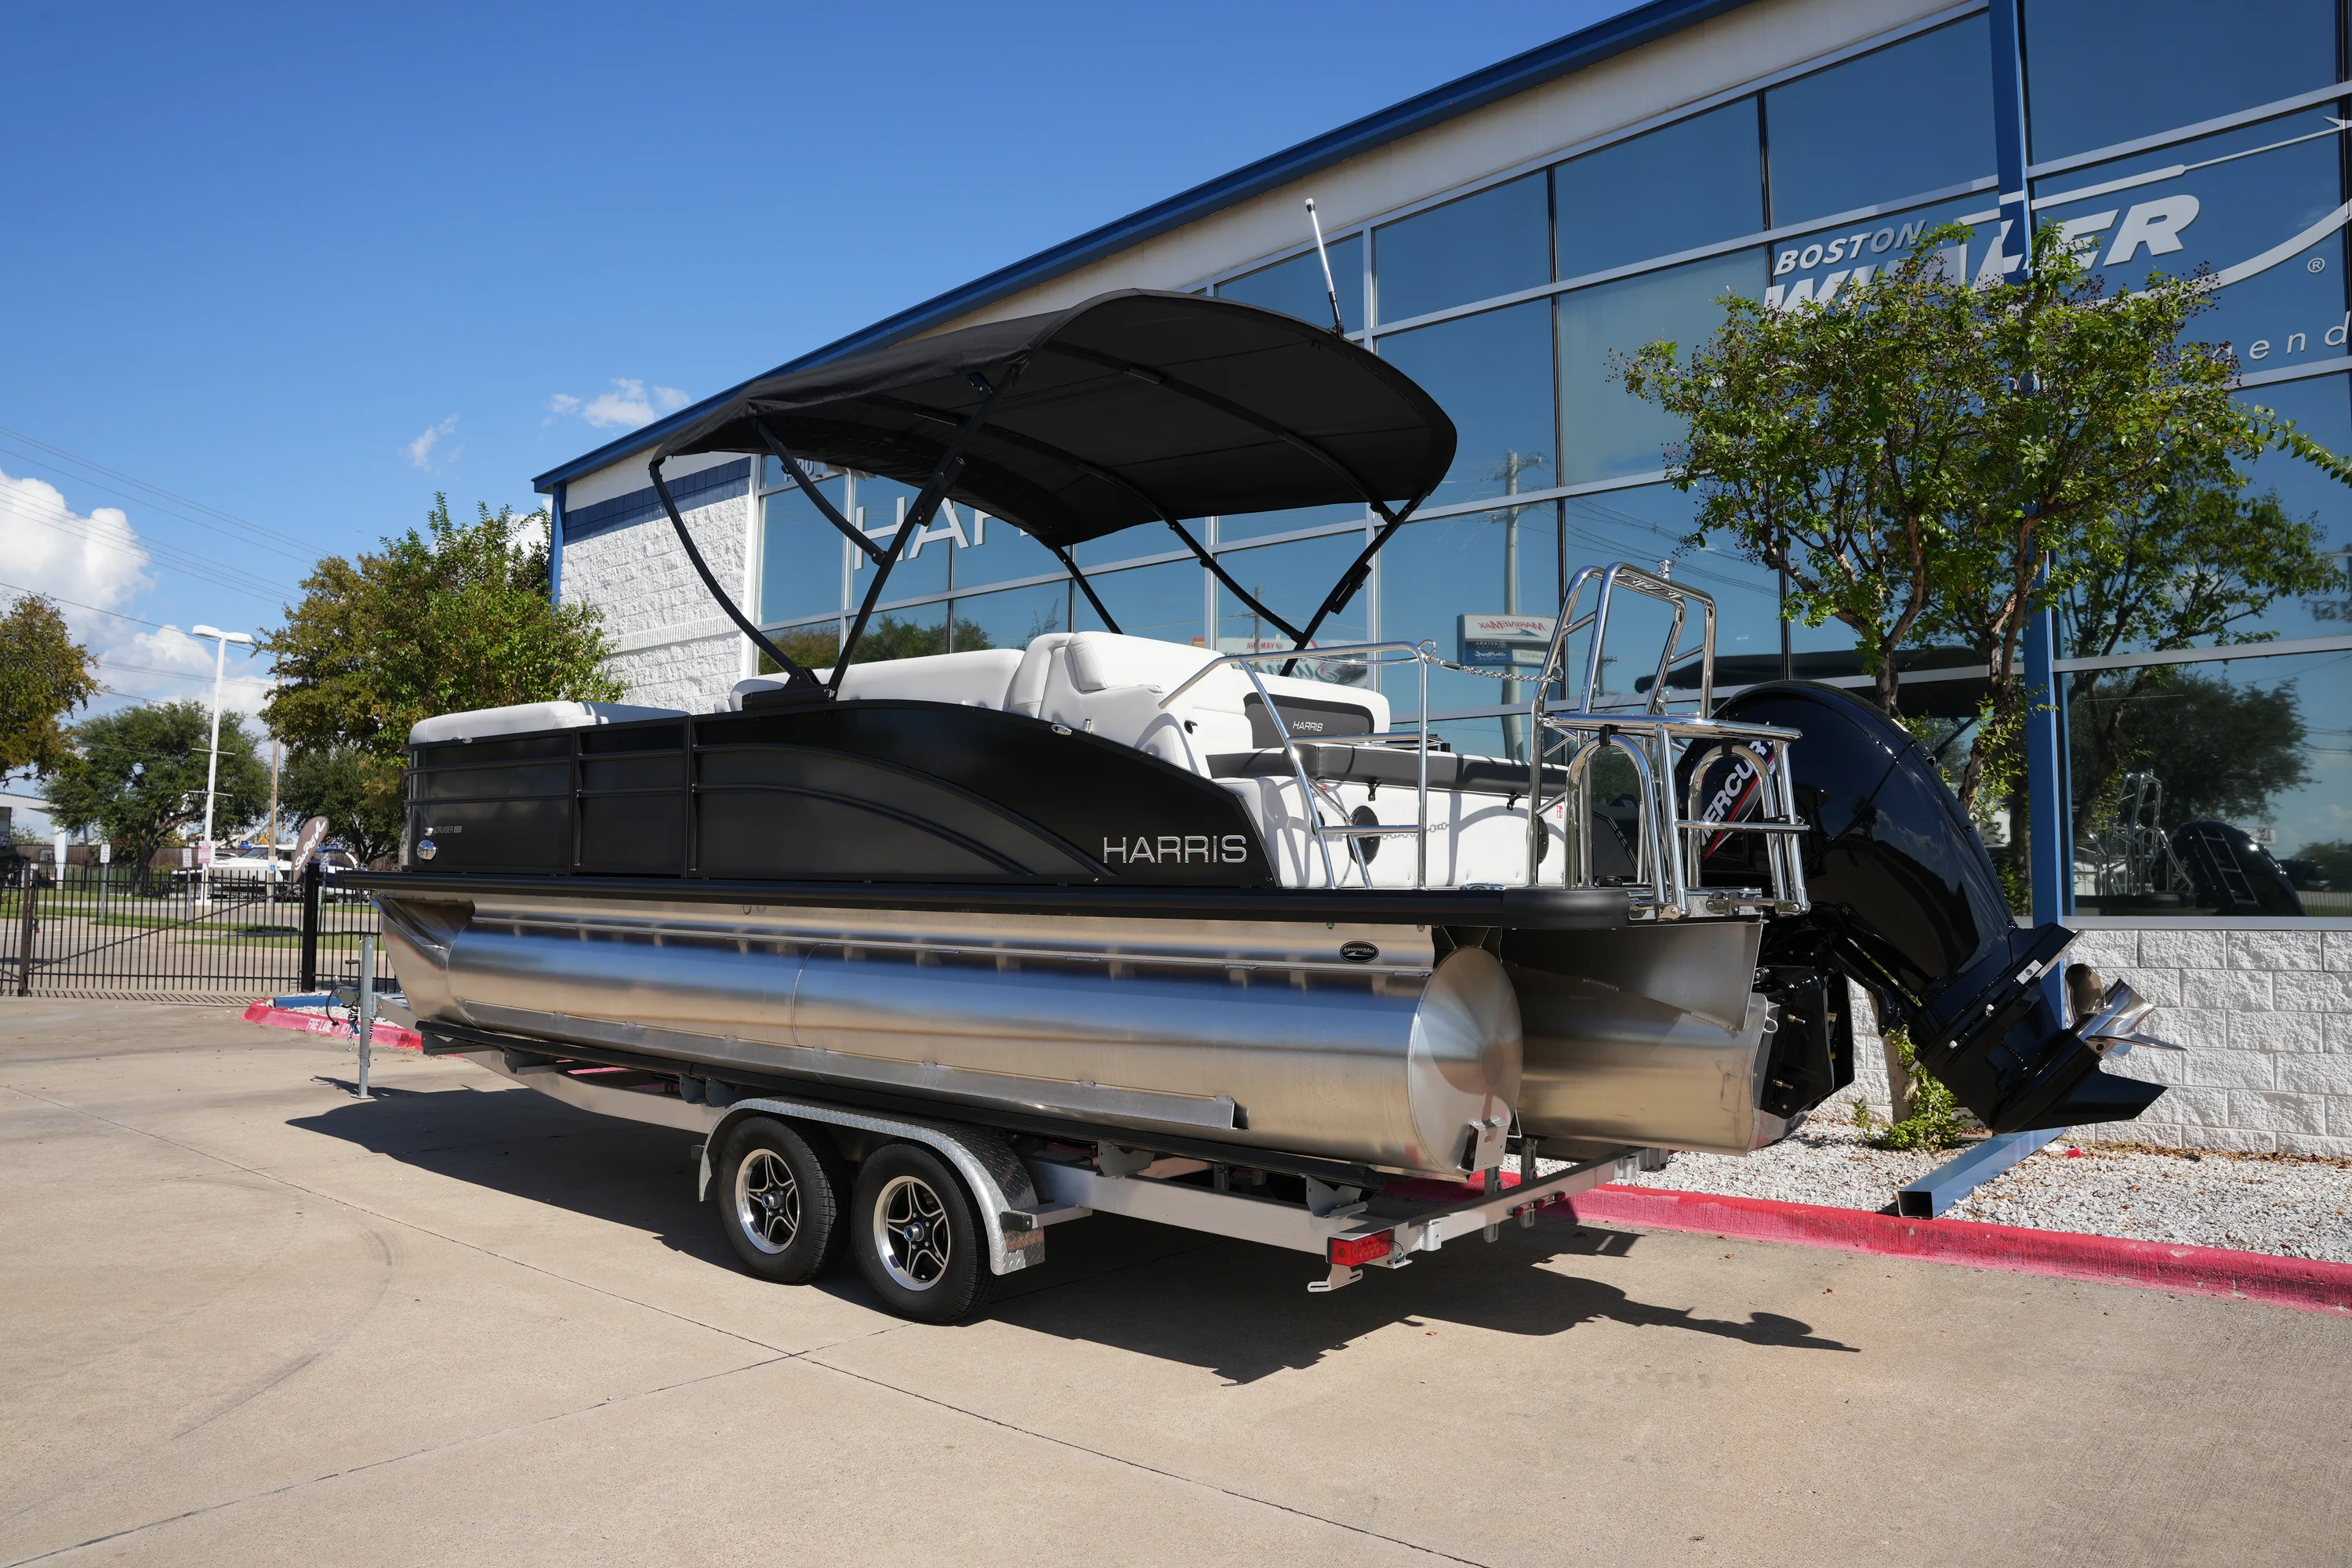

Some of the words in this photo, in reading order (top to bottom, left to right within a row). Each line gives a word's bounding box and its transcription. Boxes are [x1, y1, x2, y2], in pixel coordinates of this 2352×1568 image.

[1773, 219, 1927, 276] BOSTON
[1292, 720, 1323, 732] HARRIS
[1700, 720, 1774, 848] ERCUR
[1102, 834, 1248, 863] HARRIS
